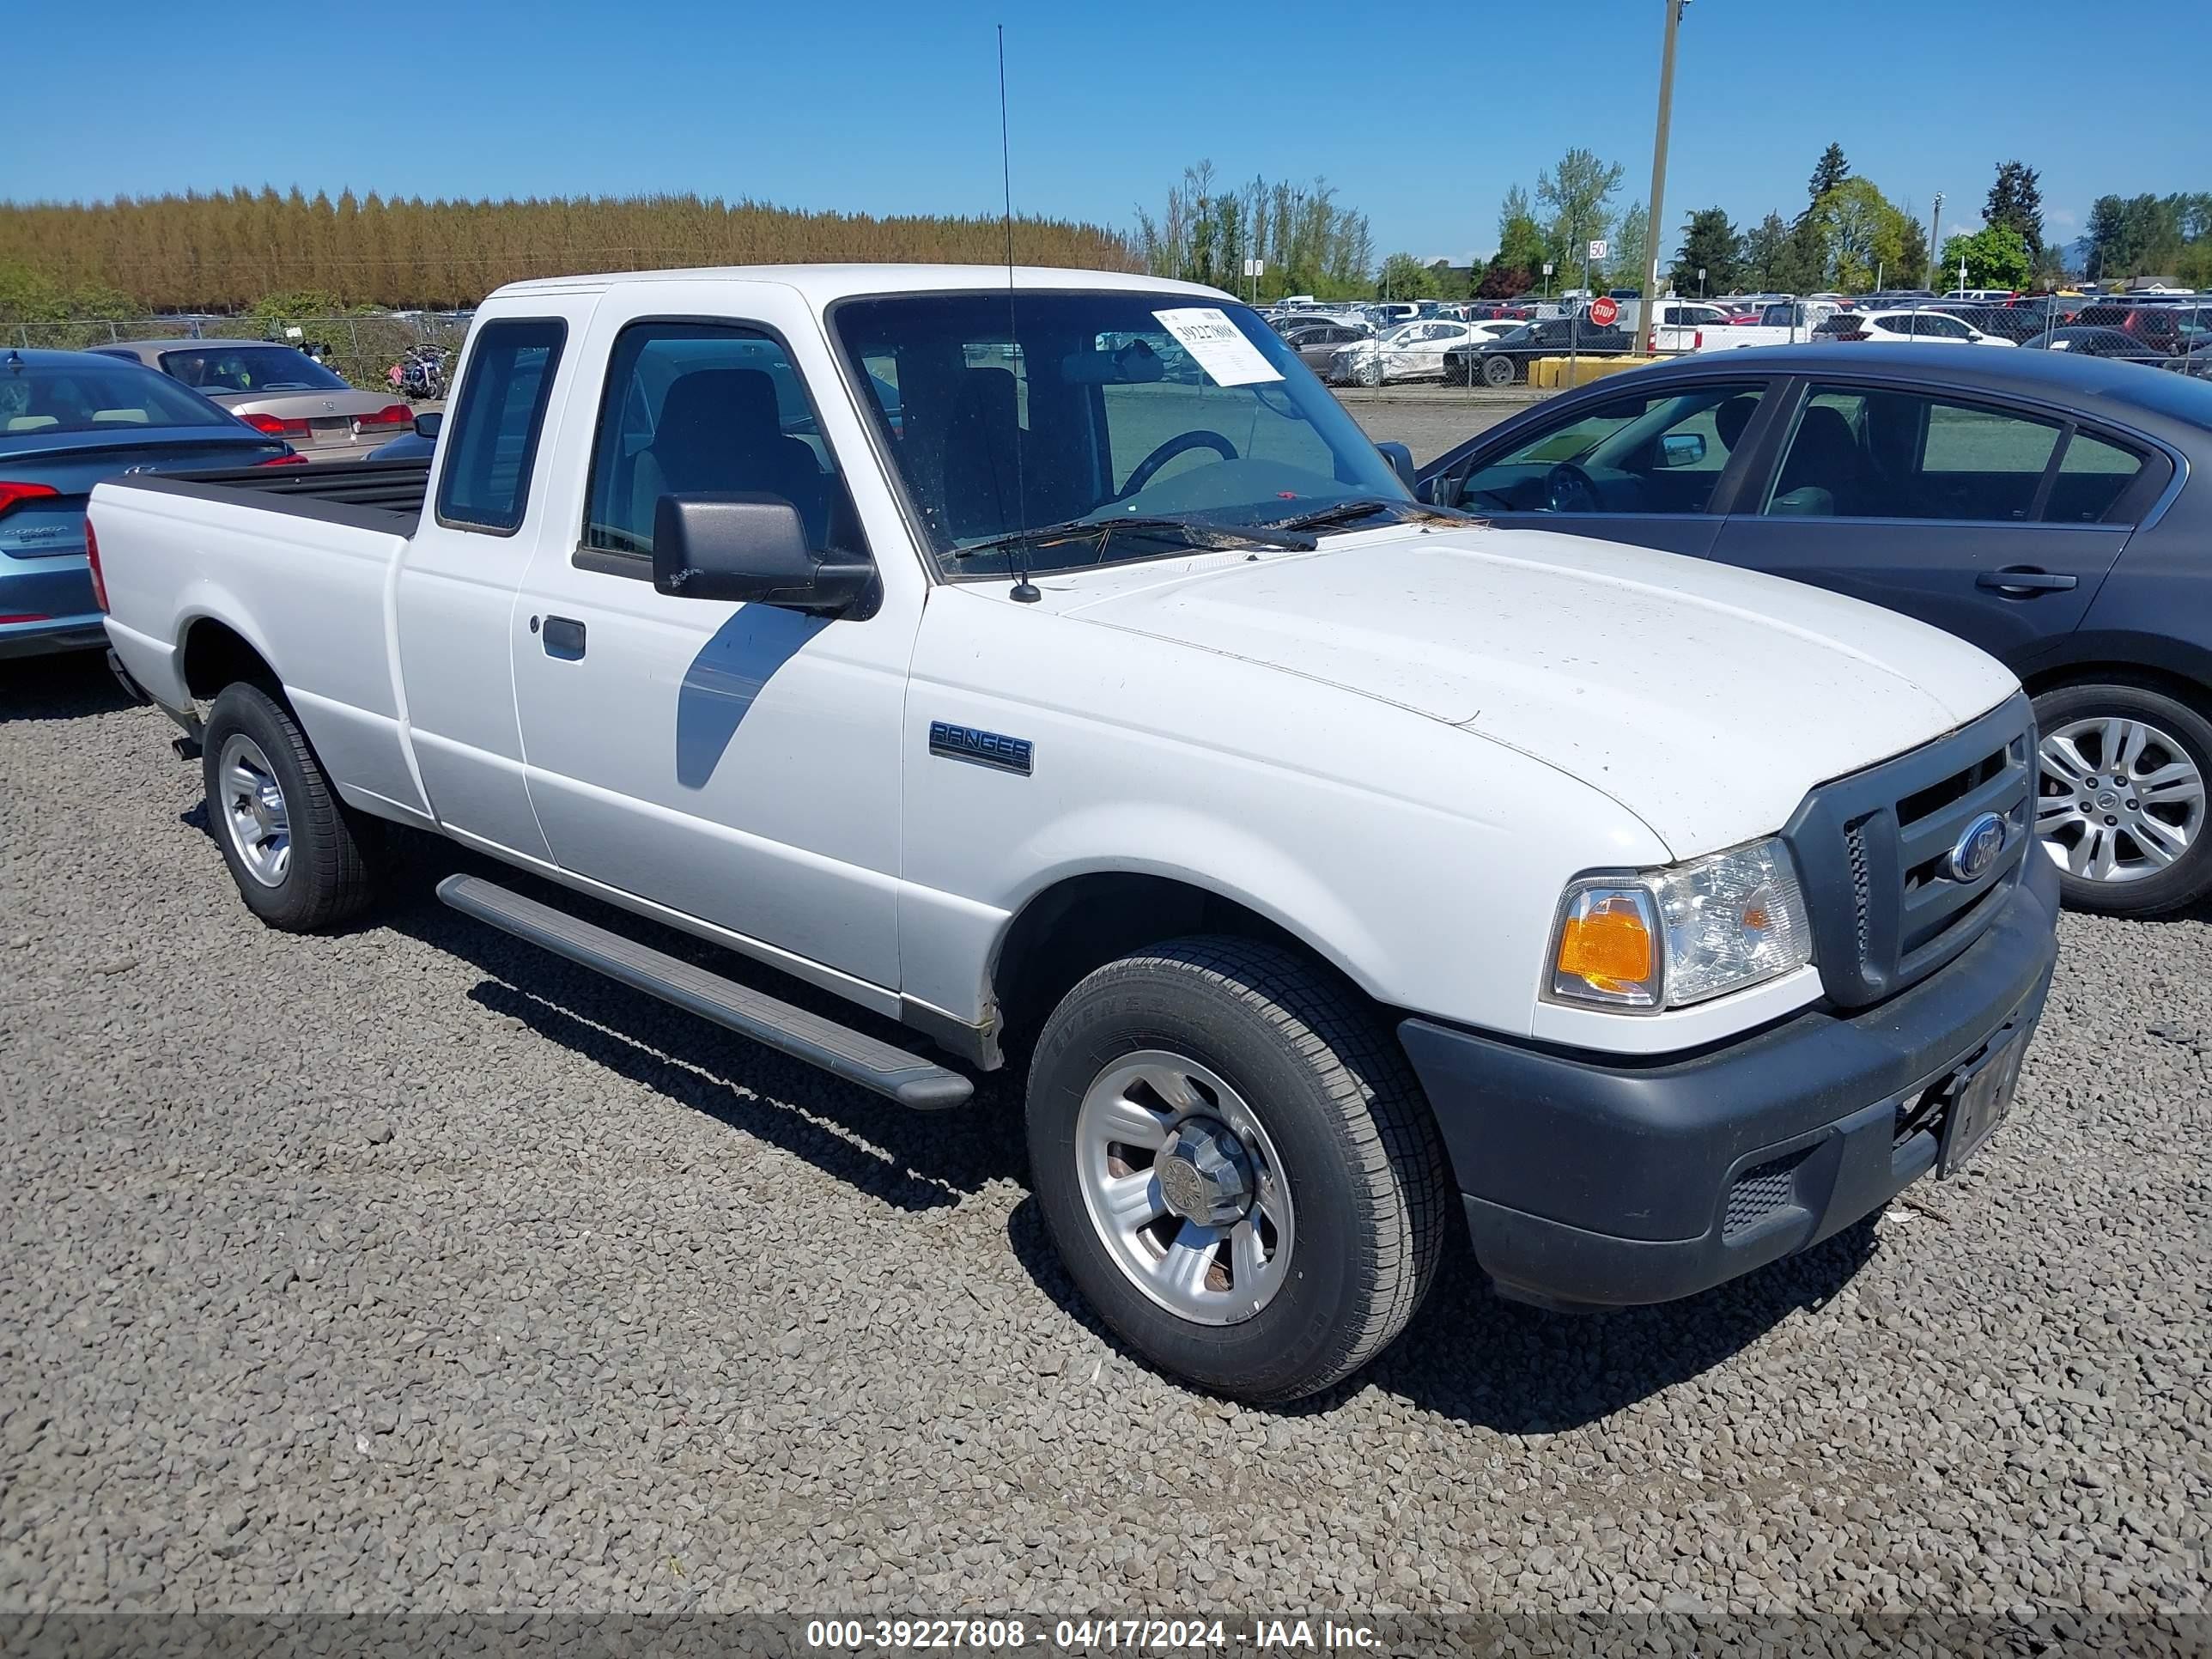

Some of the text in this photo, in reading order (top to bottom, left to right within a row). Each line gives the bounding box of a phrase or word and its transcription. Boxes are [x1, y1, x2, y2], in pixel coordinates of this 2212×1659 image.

[1590, 242, 1605, 257] 50
[1593, 304, 1615, 319] STOP
[1176, 324, 1237, 342] 39227808
[931, 722, 1032, 760] RANGER
